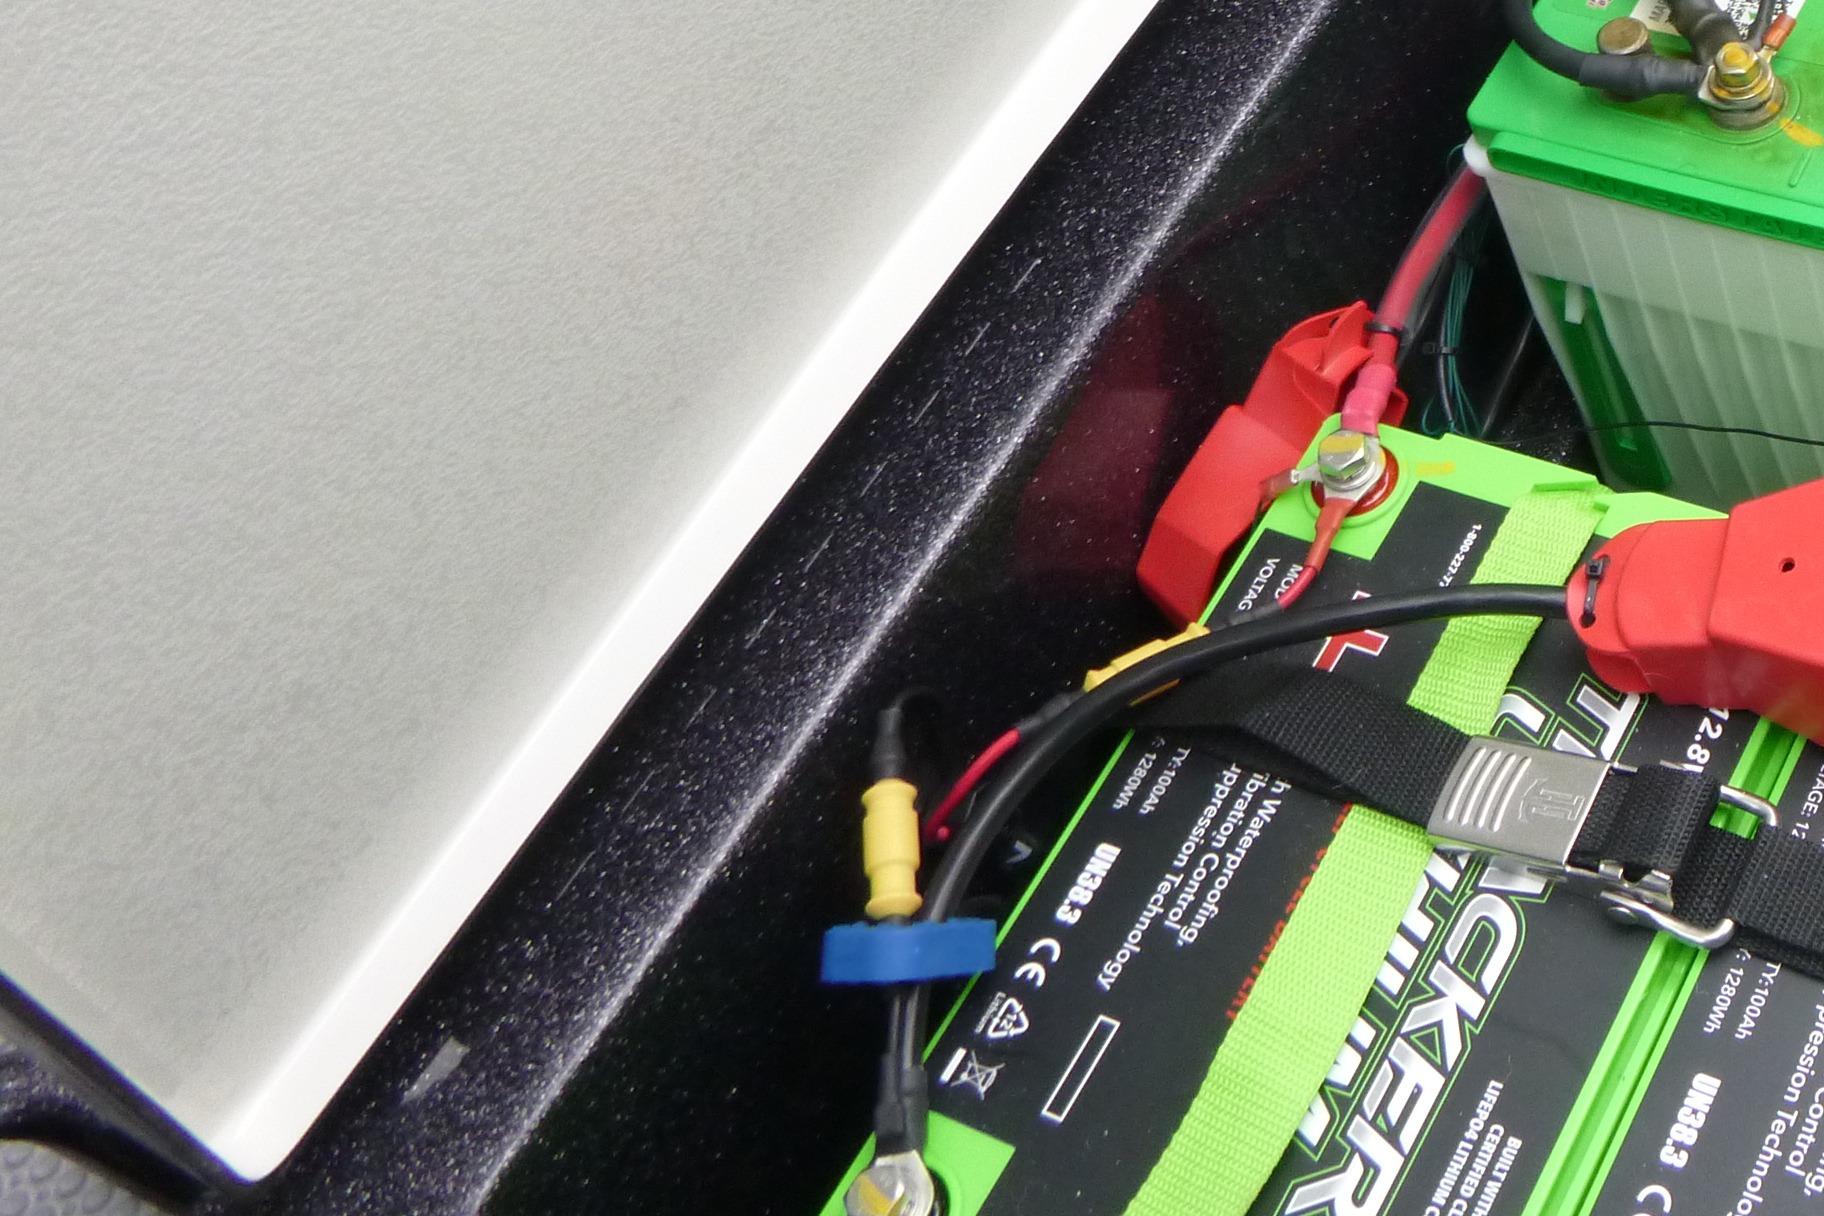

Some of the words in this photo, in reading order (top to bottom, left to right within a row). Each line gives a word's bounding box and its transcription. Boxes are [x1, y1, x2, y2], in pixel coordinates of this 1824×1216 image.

[1238, 559, 1280, 610] VOLTAG
[1114, 754, 1156, 809] 1280Wh
[1212, 774, 1267, 848] ibration
[1057, 844, 1119, 923] UN38.3
[1165, 853, 1219, 929] Control
[1179, 800, 1279, 944] Waterproofing,
[1099, 874, 1183, 989] Technology
[975, 992, 1005, 1033] Lithium
[1704, 969, 1743, 1032] 1280Wh
[1465, 1081, 1502, 1139] LIFEPO4
[1661, 1074, 1719, 1166] UN38.3
[1432, 1141, 1472, 1205] LITHIUM
[1461, 1125, 1504, 1197] CERTIFIED
[1493, 1137, 1522, 1181] BUILT
